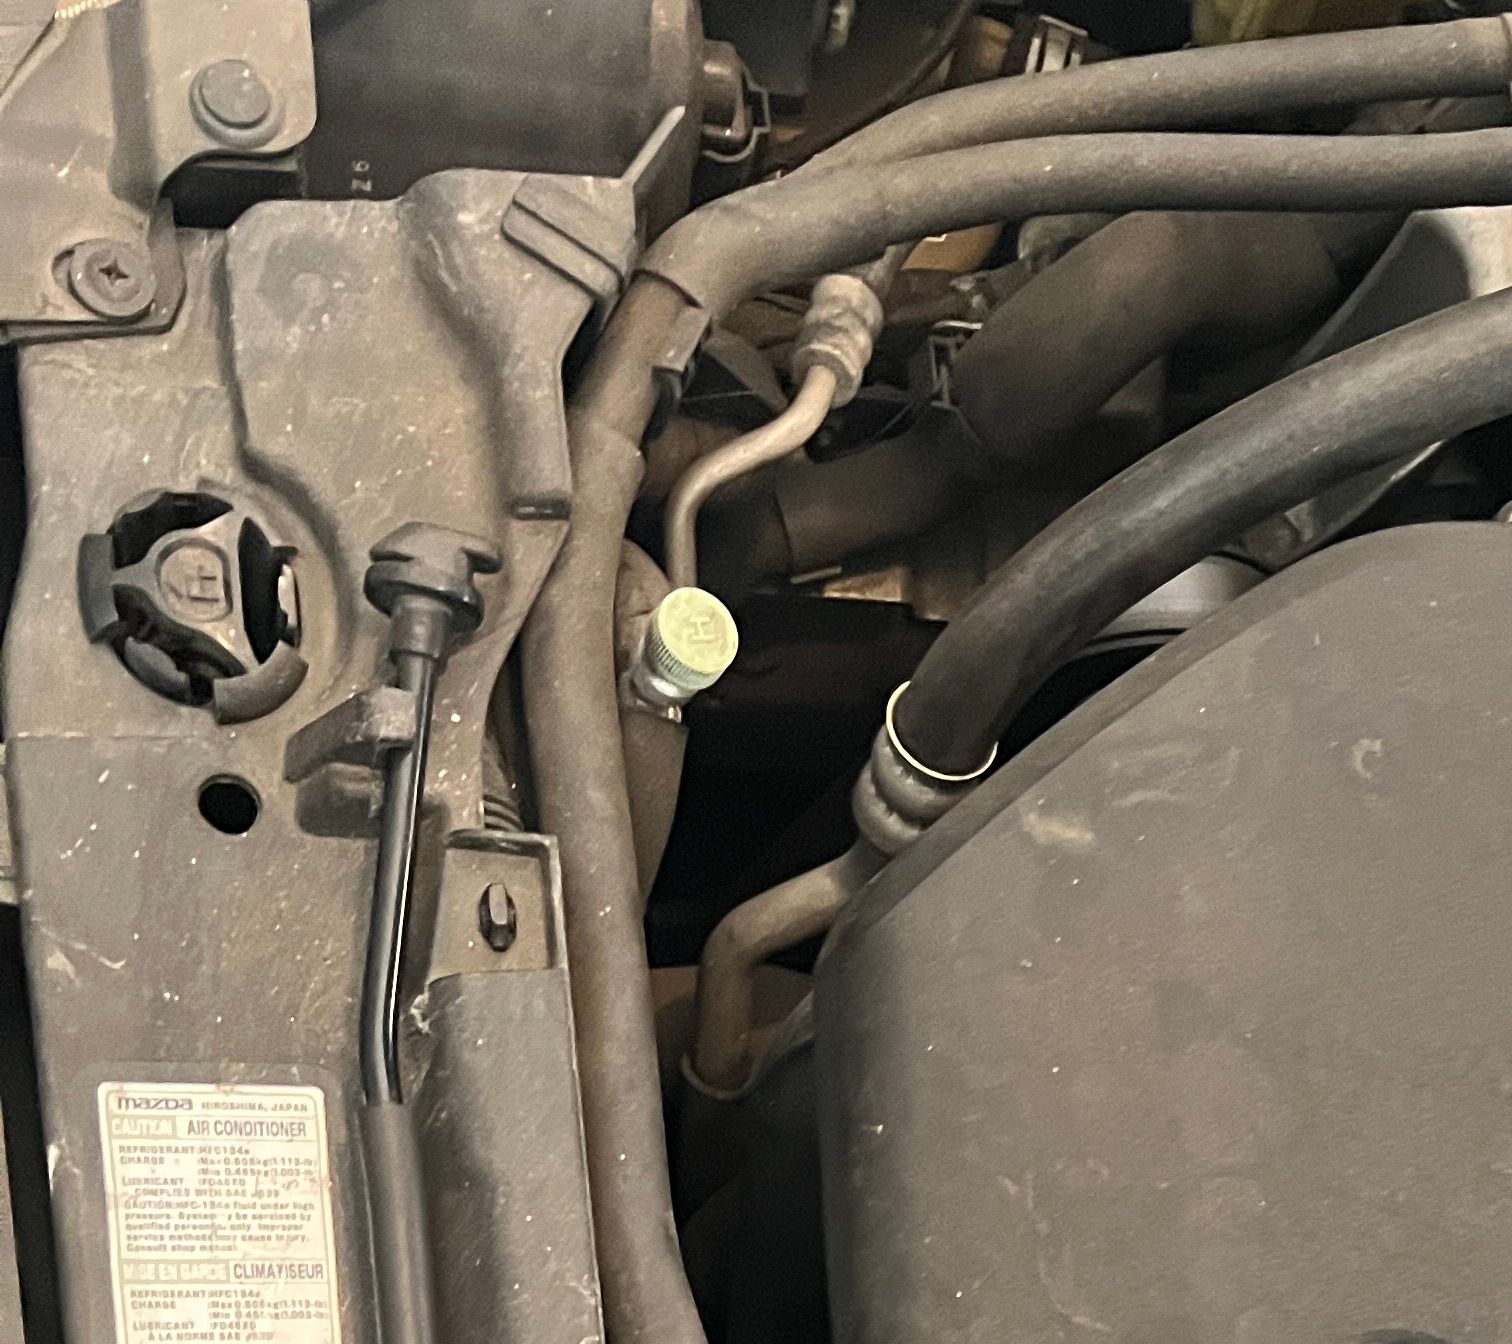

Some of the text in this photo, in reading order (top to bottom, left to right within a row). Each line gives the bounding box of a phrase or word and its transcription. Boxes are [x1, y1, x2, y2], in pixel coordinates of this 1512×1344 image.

[271, 1103, 308, 1112] JAPAN
[112, 1119, 306, 1137] CAUTION AIR CONDITIONER
[120, 1157, 165, 1165] CHARGE
[122, 1177, 185, 1186] LUBRICANT
[293, 1201, 315, 1211] high
[300, 1212, 311, 1222] by
[234, 1263, 323, 1279] CLIMATISEUR
[131, 1301, 176, 1309] CHARGE
[159, 1332, 173, 1341] LA
